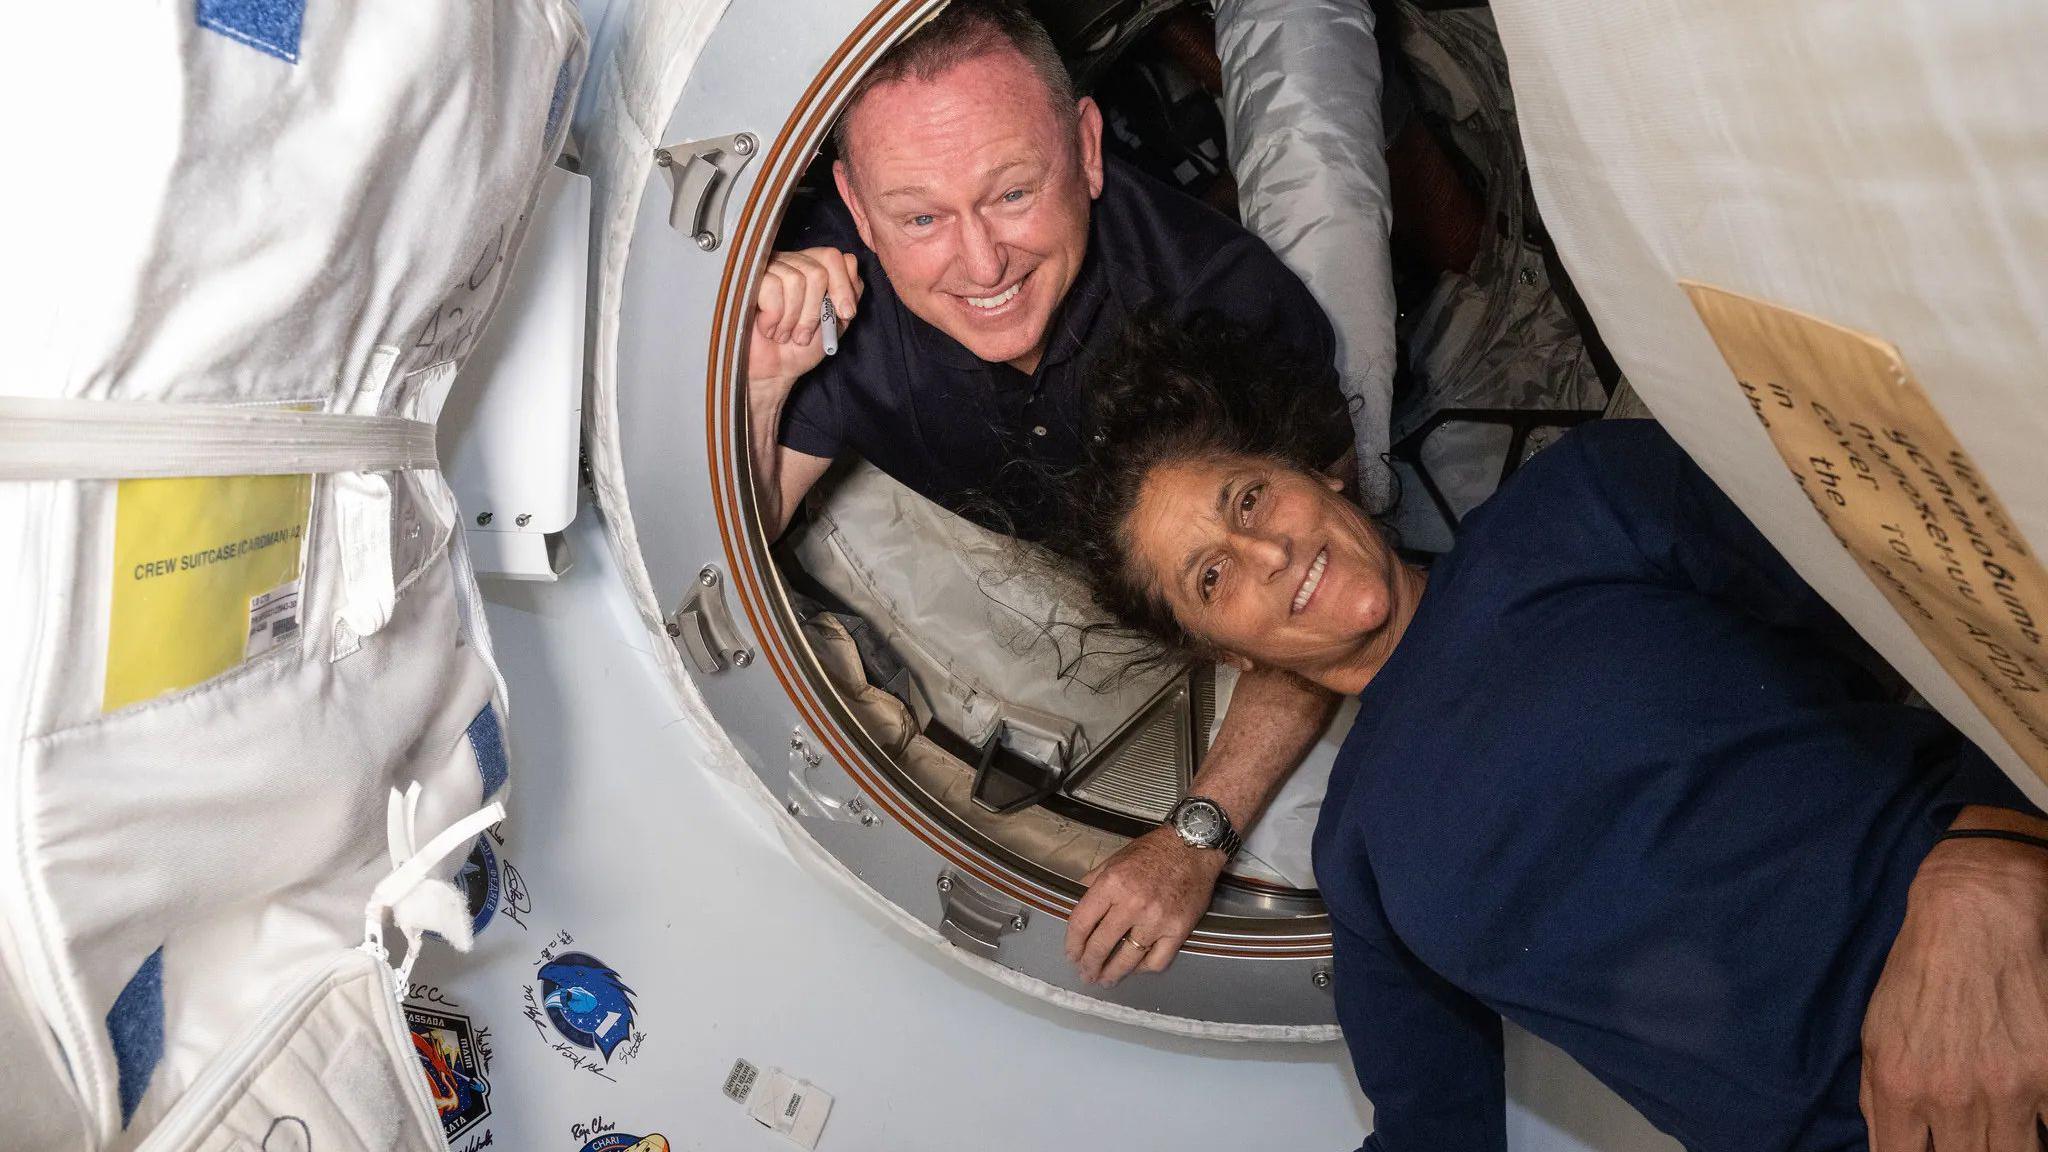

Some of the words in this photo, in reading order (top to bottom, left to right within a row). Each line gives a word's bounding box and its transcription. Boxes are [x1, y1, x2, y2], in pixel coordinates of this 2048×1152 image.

[1767, 382, 1794, 409] in
[1809, 456, 1846, 507] the
[1811, 401, 1880, 491] cover
[134, 557, 177, 581] CREW
[181, 543, 239, 571] SUITCASE
[487, 869, 499, 912] ФЕДЯЕВ
[404, 1012, 446, 1027] ASSADA
[444, 1116, 467, 1136] KATA
[592, 1136, 620, 1151] CHARI
